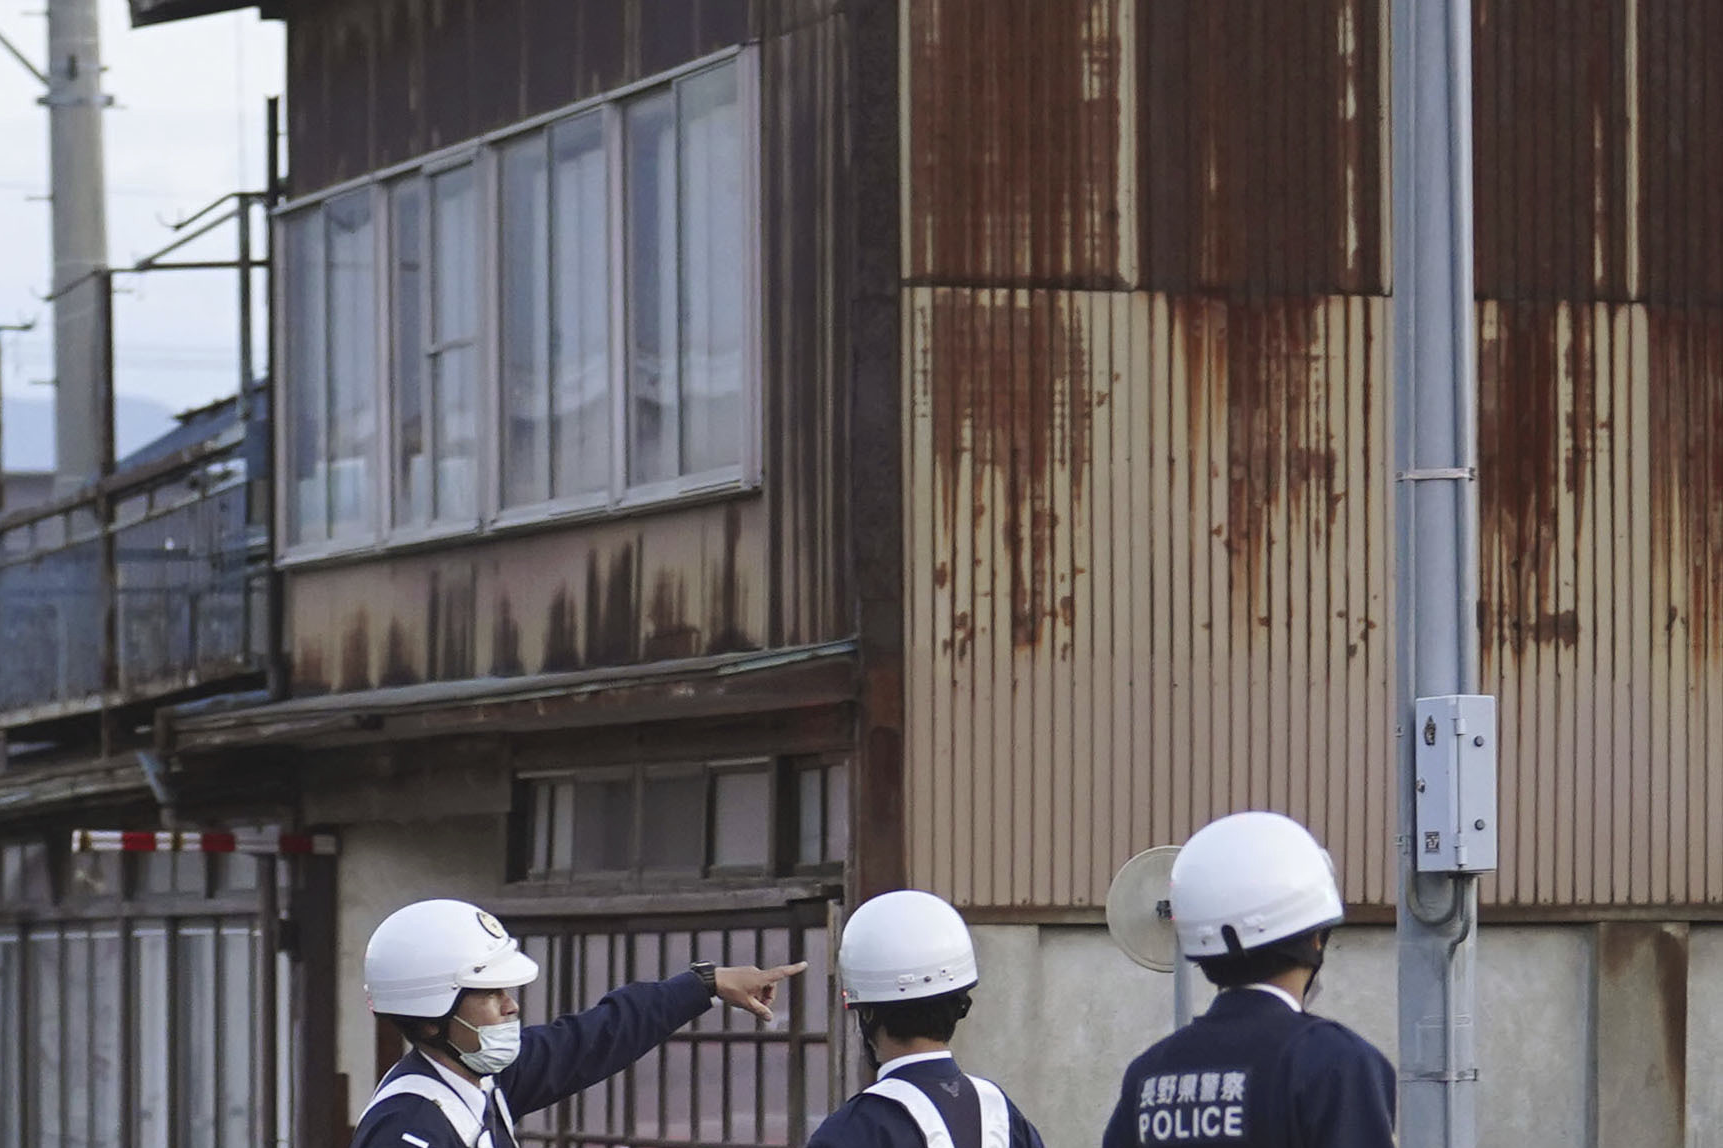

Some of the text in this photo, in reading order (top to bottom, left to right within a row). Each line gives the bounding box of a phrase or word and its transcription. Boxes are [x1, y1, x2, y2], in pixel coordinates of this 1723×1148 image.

[1139, 1071, 1246, 1108] 長野県警察
[1138, 1106, 1245, 1144] POLICE
